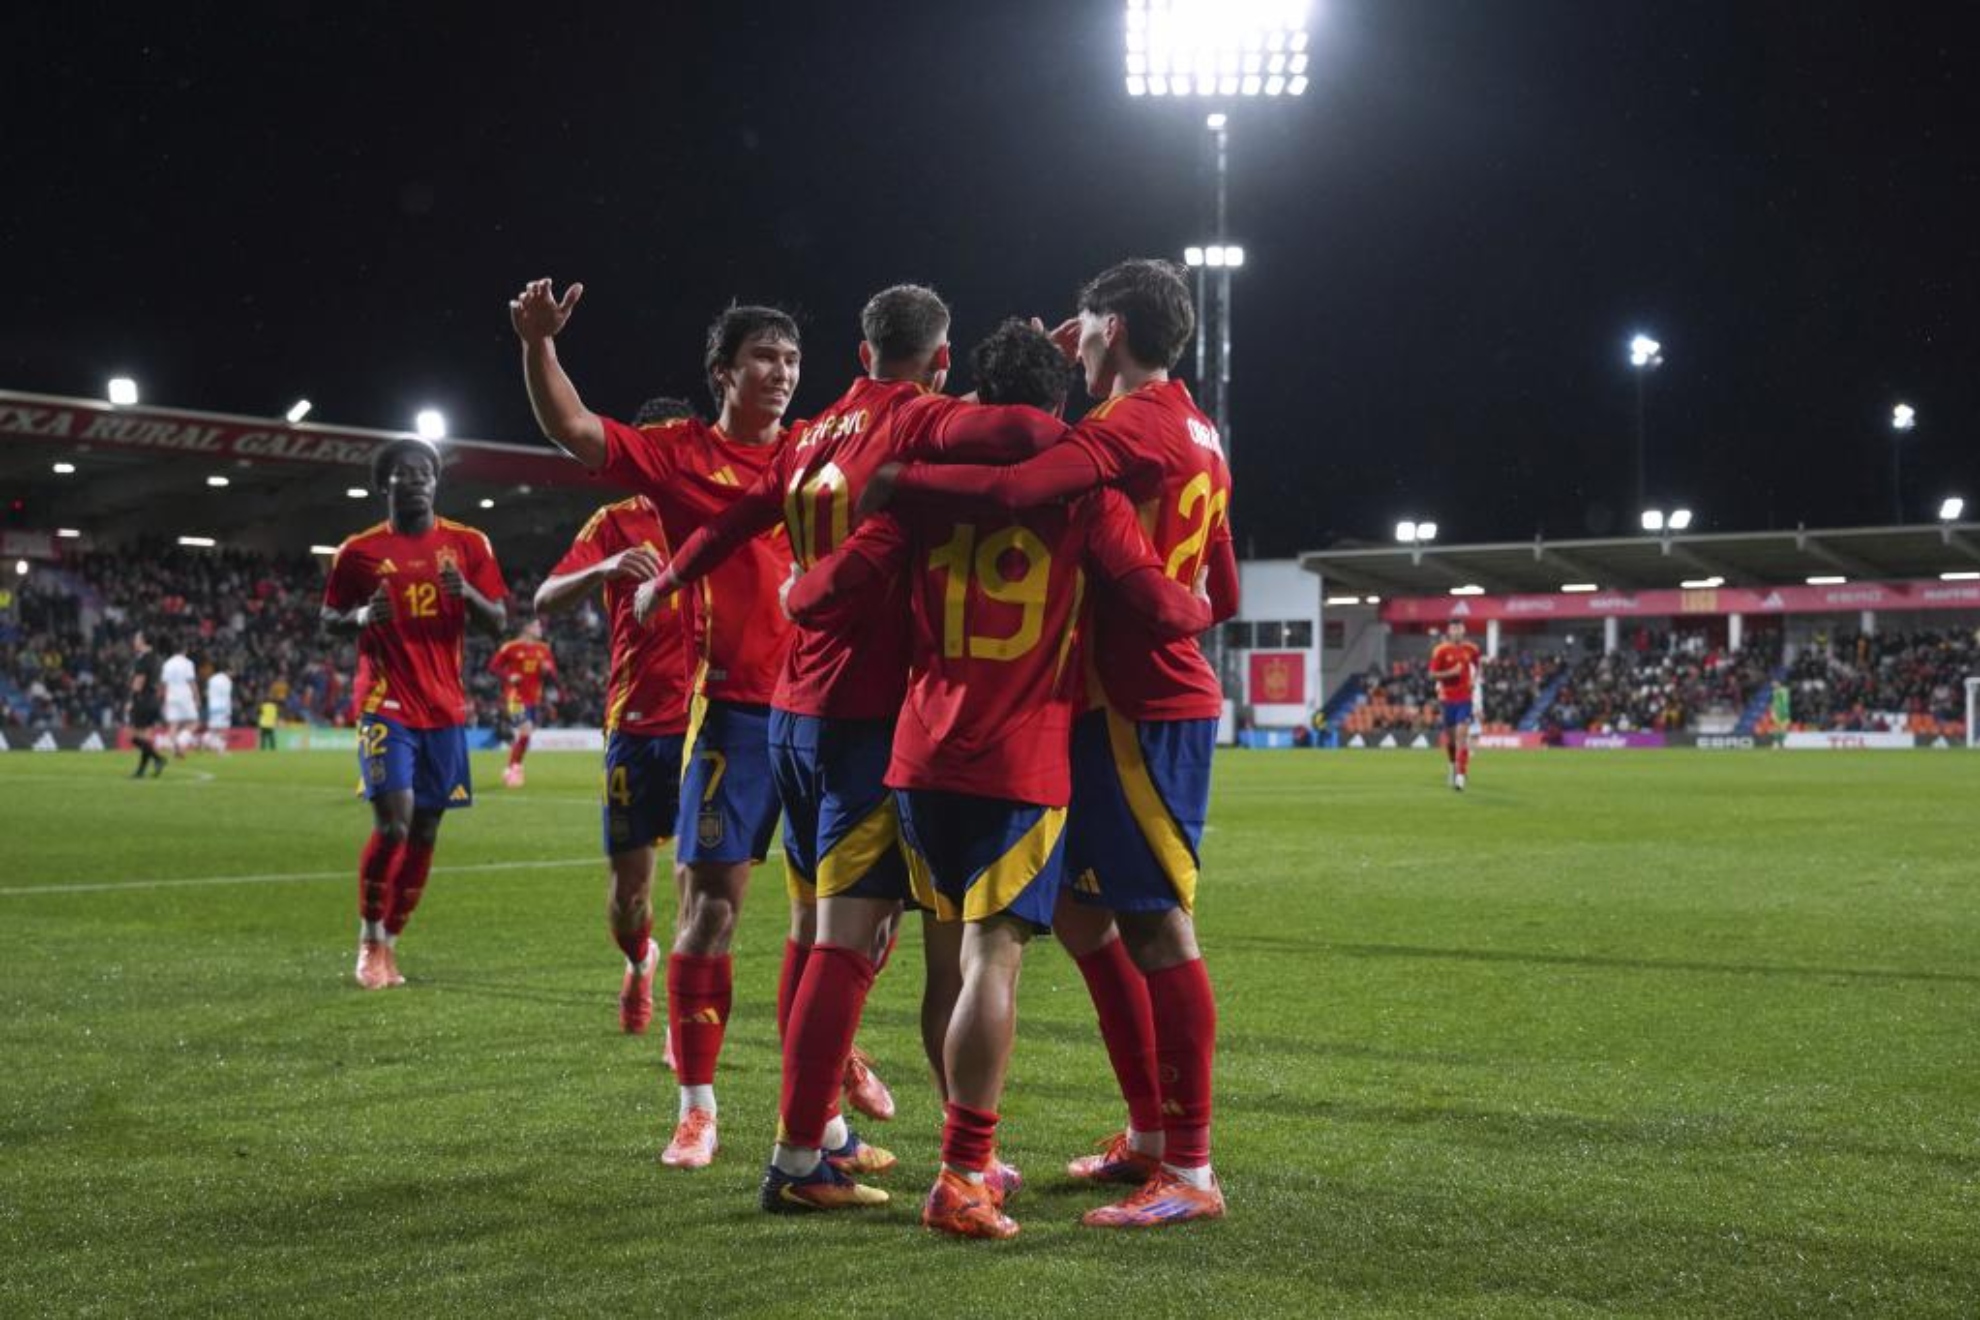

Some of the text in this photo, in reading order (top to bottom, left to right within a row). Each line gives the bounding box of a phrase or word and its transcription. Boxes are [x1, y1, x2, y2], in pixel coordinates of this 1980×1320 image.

[78, 413, 225, 450] RURAL
[785, 462, 848, 568] 10
[405, 582, 437, 617] 12
[928, 524, 1051, 661] 19
[361, 722, 388, 758] 12
[1827, 735, 1866, 748] TCL
[610, 766, 631, 806] 4
[699, 750, 726, 802] 7
